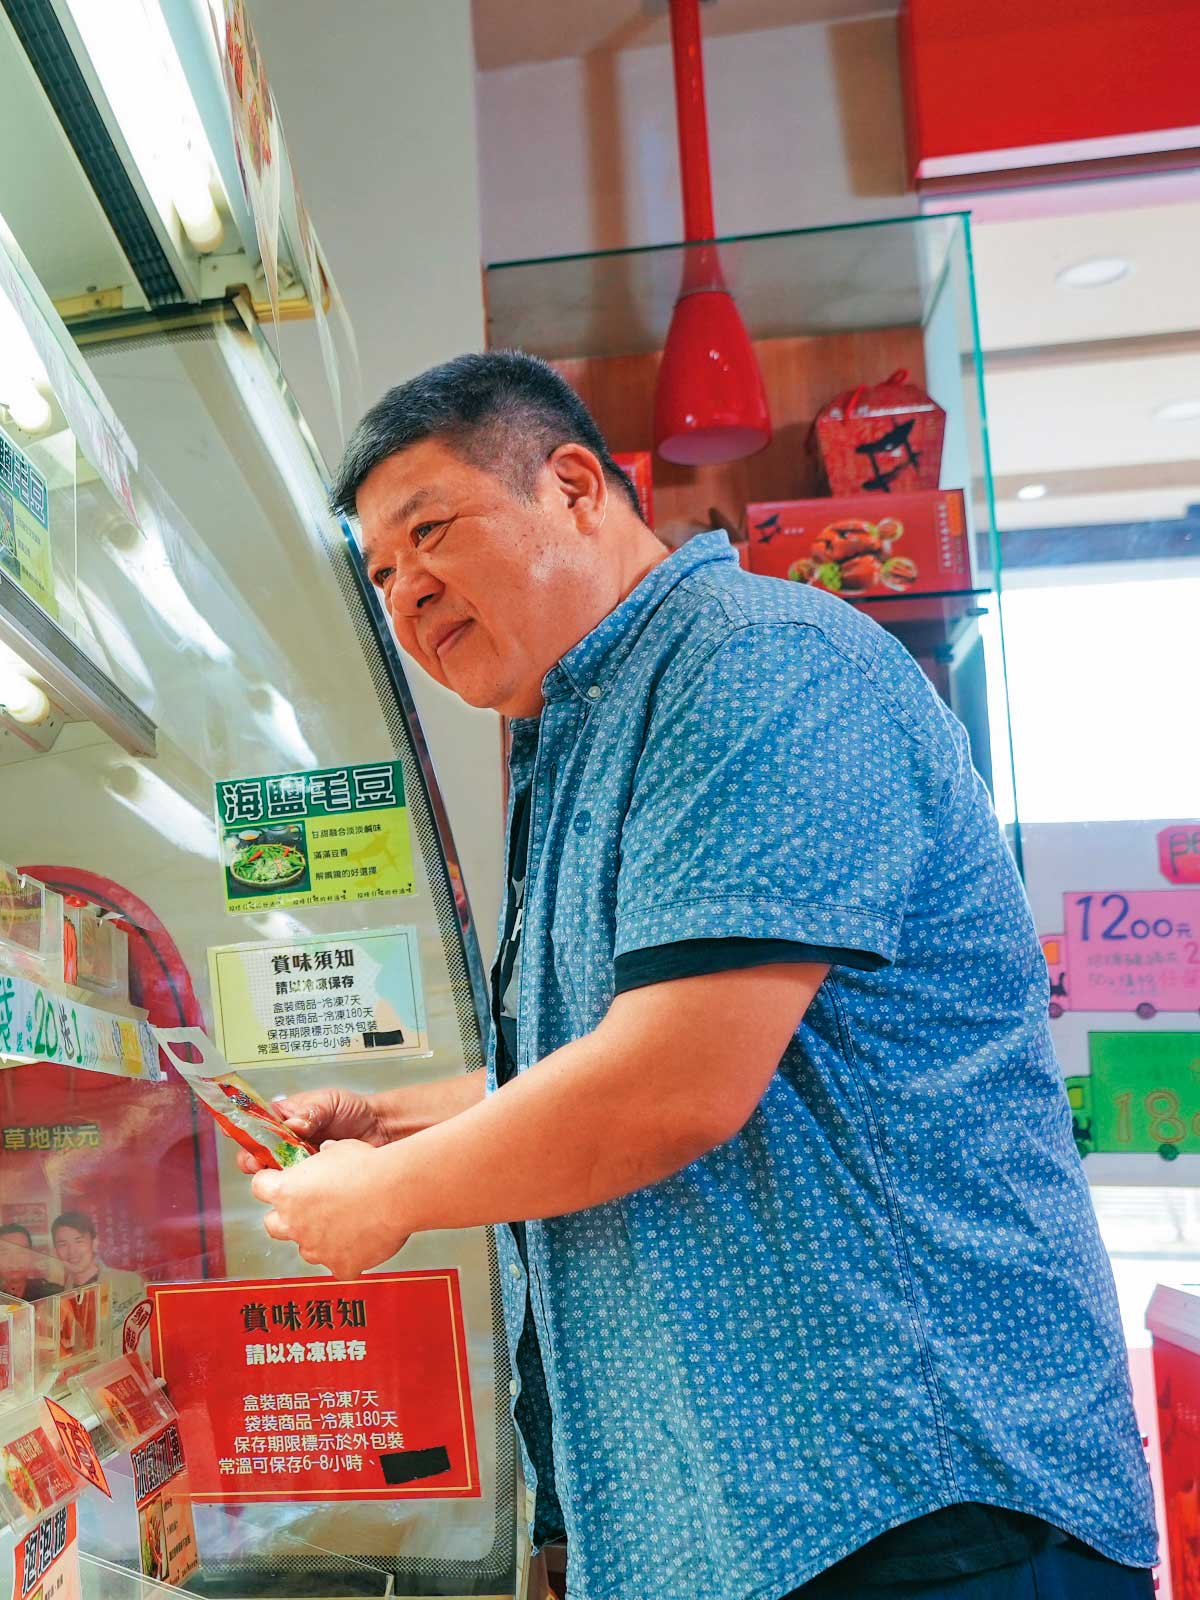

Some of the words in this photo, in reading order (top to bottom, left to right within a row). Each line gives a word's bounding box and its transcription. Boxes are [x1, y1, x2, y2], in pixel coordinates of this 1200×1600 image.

[223, 765, 396, 824] 海鹽毛豆
[271, 949, 354, 974] 賞味須知
[274, 1008, 373, 1027] 袋裝商品-冷凍180天
[267, 1021, 377, 1040] 保存期限標示於外包裝
[3, 1125, 100, 1151] 草地狀元
[240, 1298, 368, 1333] 賞味須知
[245, 1340, 367, 1366] 請以冷凍保存
[242, 1390, 379, 1411] 盒裝商品-冷凍7天
[244, 1411, 398, 1432] 袋裝商品-冷凍180天
[233, 1432, 405, 1453] 保存期限標示於外包裝
